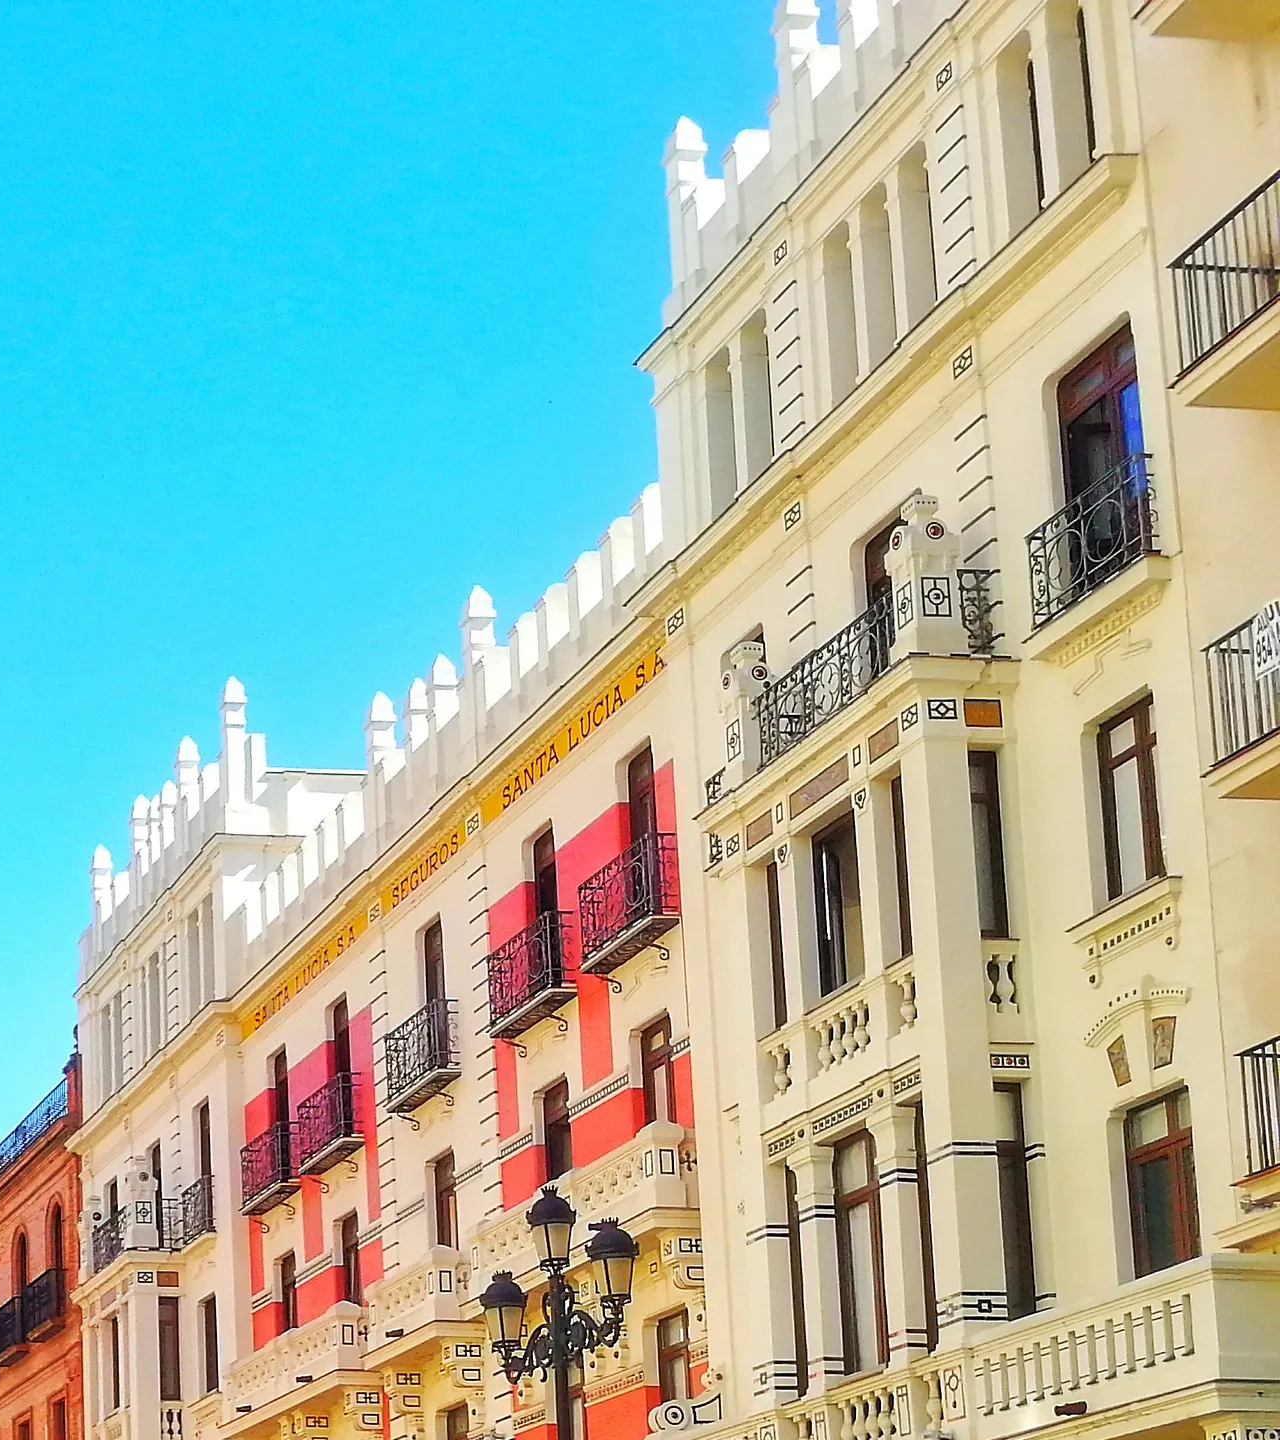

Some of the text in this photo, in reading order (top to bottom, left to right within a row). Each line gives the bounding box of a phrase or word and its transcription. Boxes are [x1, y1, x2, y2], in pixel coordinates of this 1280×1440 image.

[502, 742, 560, 810] SANTA
[391, 832, 459, 909] SEGUROS
[295, 949, 331, 994] LUCIA
